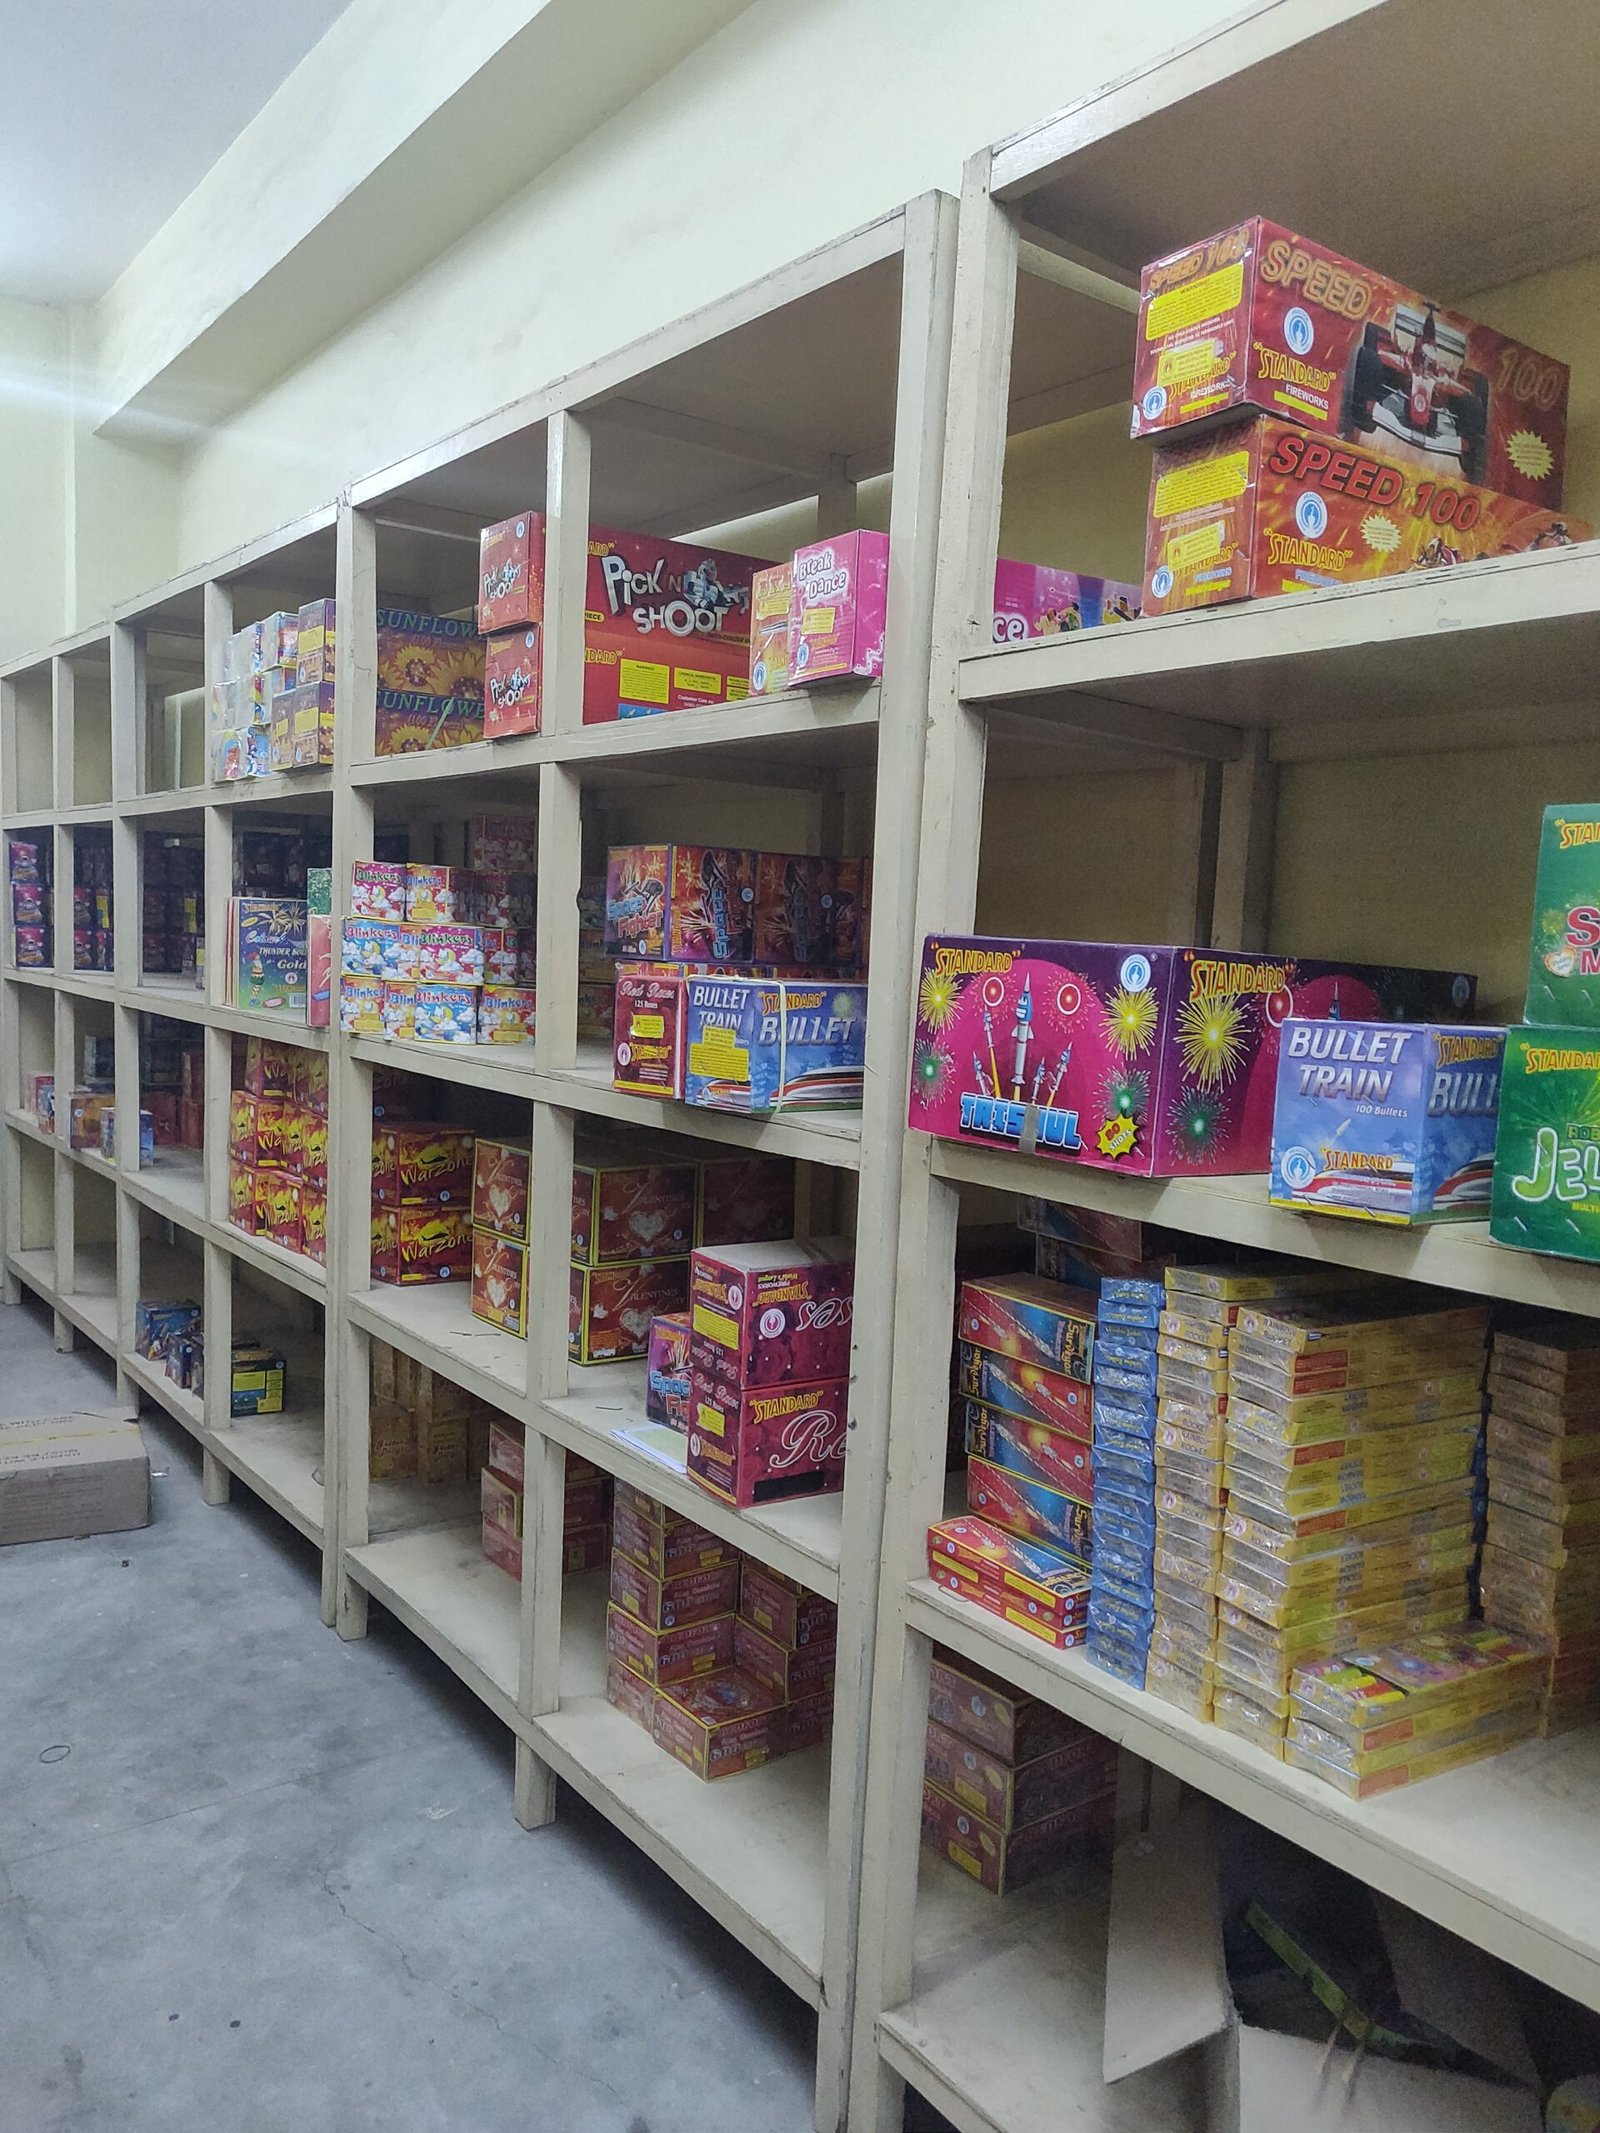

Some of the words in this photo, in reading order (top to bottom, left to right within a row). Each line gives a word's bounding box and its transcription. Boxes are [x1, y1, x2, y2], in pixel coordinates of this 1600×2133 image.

[1260, 240, 1373, 321] SPEED
[1497, 346, 1562, 411] 100
[1285, 384, 1330, 410] FIREWORKS
[1270, 436, 1403, 507] SPEED
[1415, 482, 1481, 531] 100
[799, 552, 832, 582] Break
[808, 571, 847, 600] Dance
[633, 600, 730, 637] SHOOT
[356, 868, 401, 883] Blinkers
[407, 874, 442, 888] Blinkers
[347, 926, 399, 942] Blinkers
[618, 910, 663, 939] Fighter
[420, 930, 473, 946] Blinkers
[259, 947, 290, 957] THUNDER
[276, 959, 307, 970] Gold
[415, 991, 472, 1007] Blinkers
[484, 996, 533, 1010] Blinkers
[693, 985, 750, 1011] BULLET
[758, 991, 827, 1016] "STNDARD"
[699, 1010, 743, 1030] TRAIN
[758, 1016, 857, 1047] BULLET
[1288, 1026, 1412, 1065] BULLET
[1300, 1064, 1394, 1103] TRAIN
[1356, 1104, 1373, 1114] 100
[1374, 1106, 1408, 1118] Bullets
[1109, 1128, 1133, 1151] SHOTS
[401, 1157, 474, 1188] Warzone
[401, 1232, 474, 1263] Warzone
[1061, 1320, 1078, 1375] Surveyor
[970, 1349, 983, 1394] Surveyor
[978, 1408, 990, 1454] Surveyor
[1182, 1506, 1208, 1521] ROCKET
